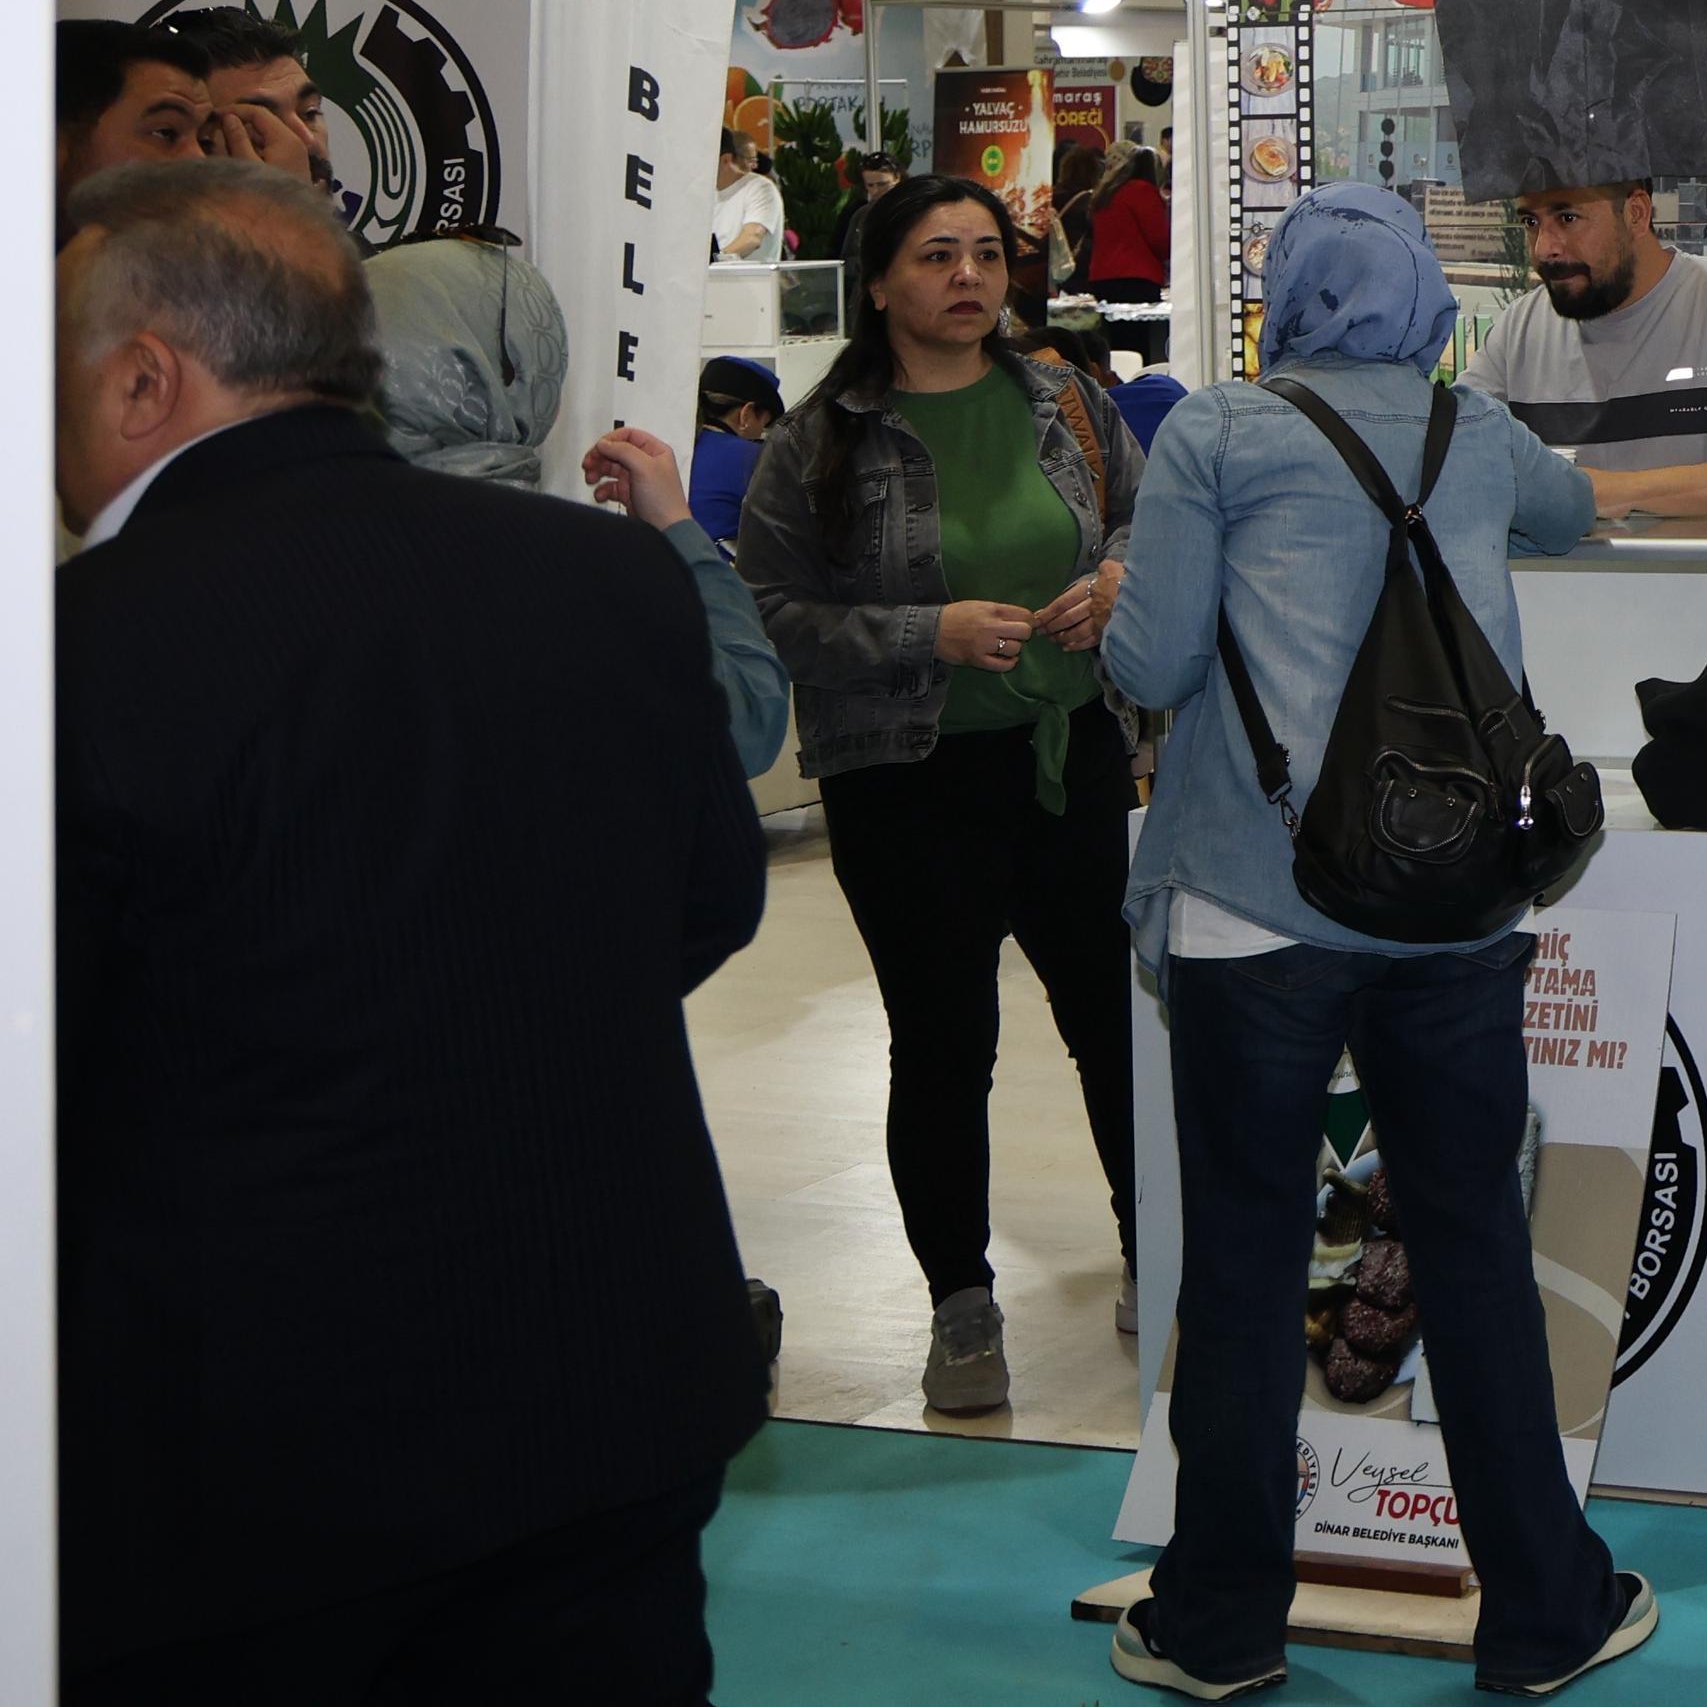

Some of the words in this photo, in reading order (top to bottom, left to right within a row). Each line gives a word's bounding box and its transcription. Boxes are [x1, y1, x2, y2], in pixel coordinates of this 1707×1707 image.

[613, 65, 661, 433] BELE
[1535, 928, 1571, 966] HİÇ
[1587, 1040, 1628, 1070] MI?
[1629, 1152, 1679, 1301] BORSASI
[1331, 1447, 1430, 1503] Veysel
[1314, 1521, 1349, 1537] DİNAR
[1352, 1527, 1406, 1544] BELEDİYE
[1408, 1534, 1459, 1549] BAŞKANI
